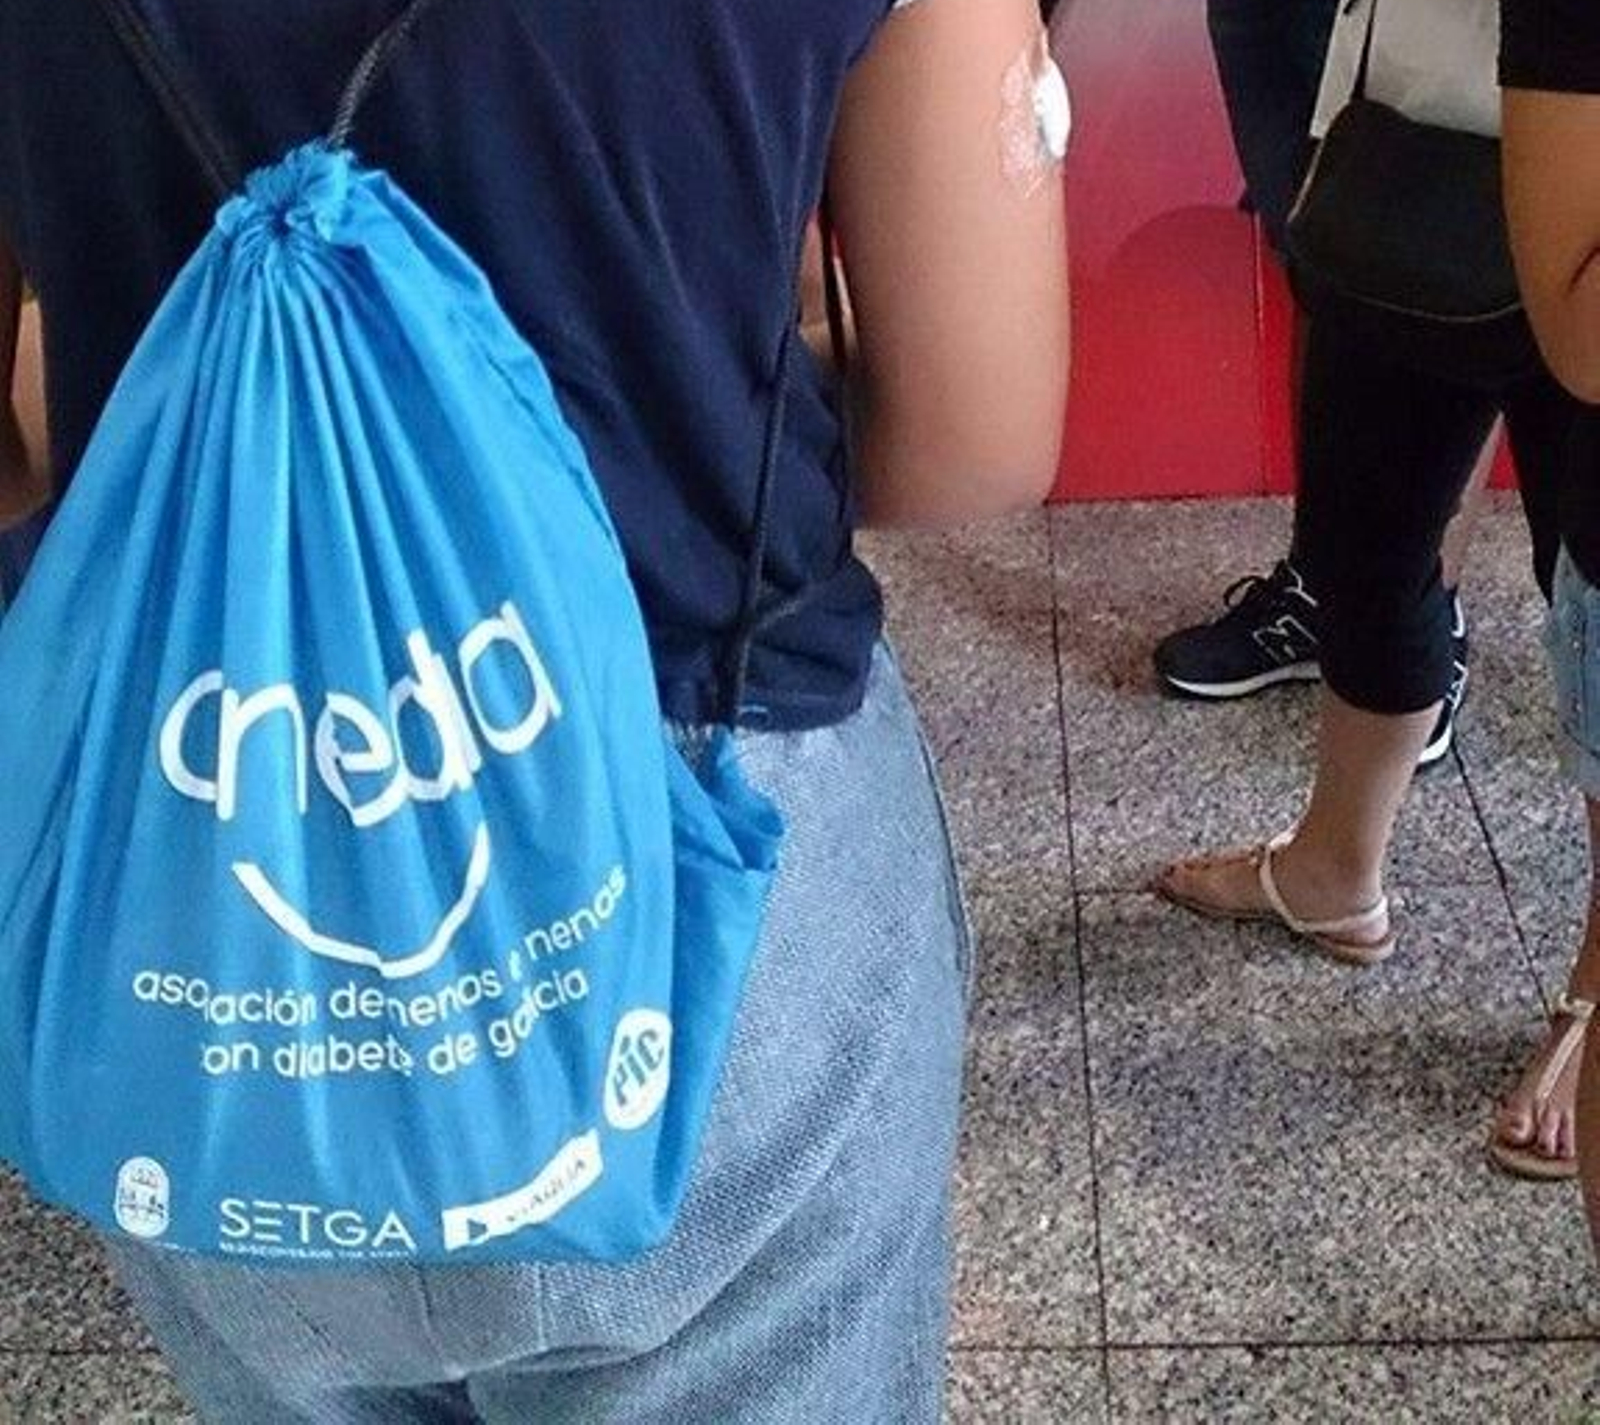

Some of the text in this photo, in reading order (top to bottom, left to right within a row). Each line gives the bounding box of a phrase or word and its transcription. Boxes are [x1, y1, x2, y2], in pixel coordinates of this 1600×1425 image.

[329, 980, 384, 1019] de
[202, 1042, 259, 1074] on
[427, 1032, 478, 1075] de
[219, 1197, 417, 1252] SETGA
